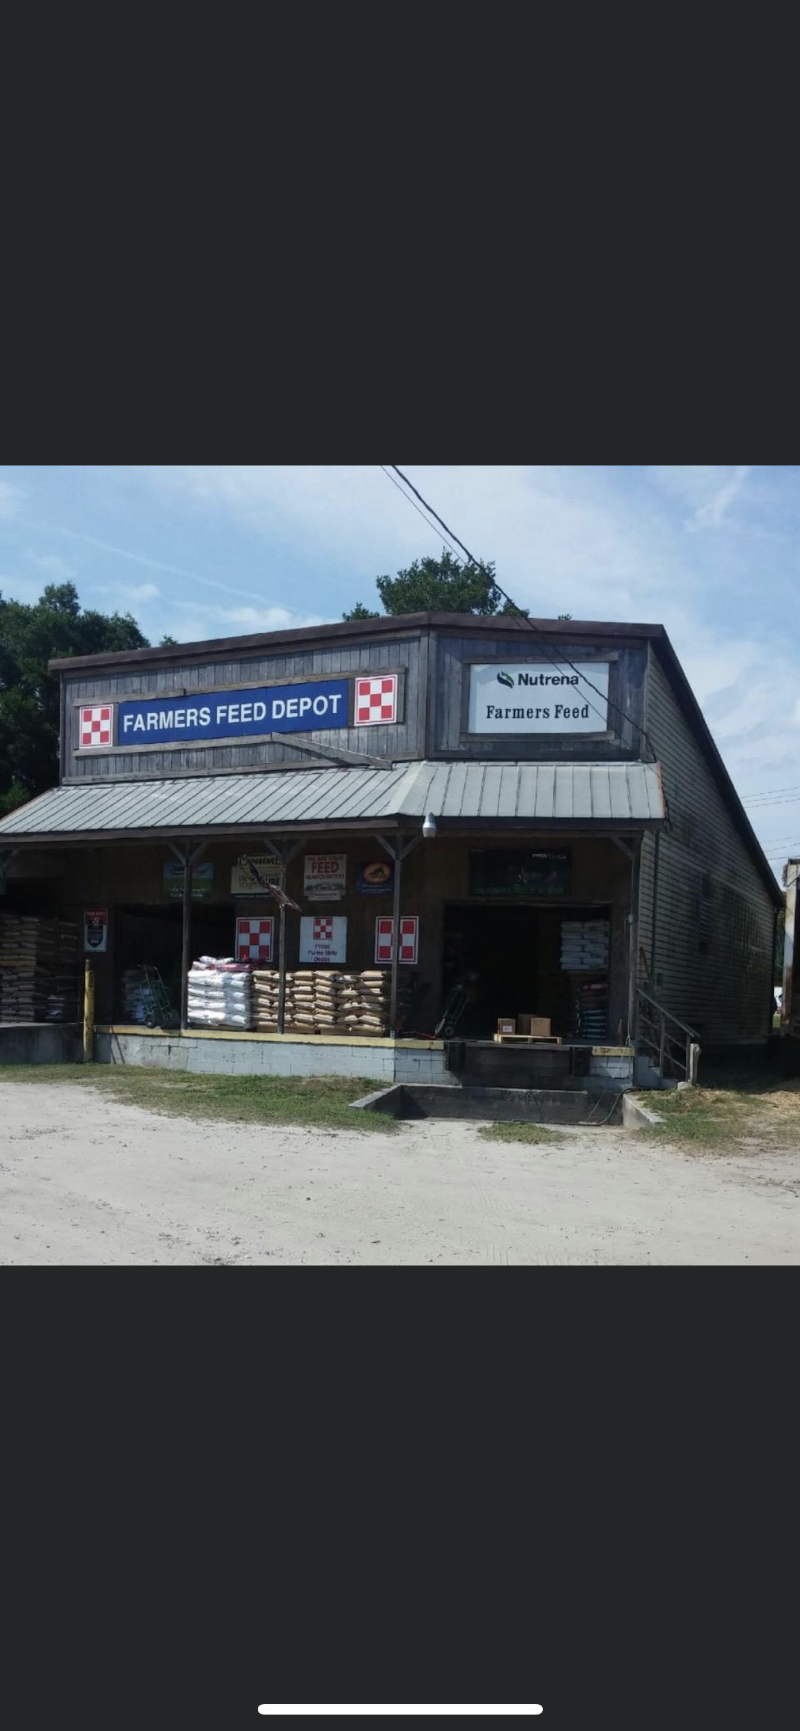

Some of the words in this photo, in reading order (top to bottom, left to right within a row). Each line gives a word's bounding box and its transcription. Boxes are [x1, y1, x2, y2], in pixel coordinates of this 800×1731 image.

[518, 673, 579, 686] Nutrena
[123, 709, 211, 733] FARMERS
[216, 702, 267, 725] FEED
[271, 694, 342, 720] DEPOT
[486, 705, 550, 719] Farmers
[554, 704, 589, 719] Feed
[311, 861, 339, 874] FEED
